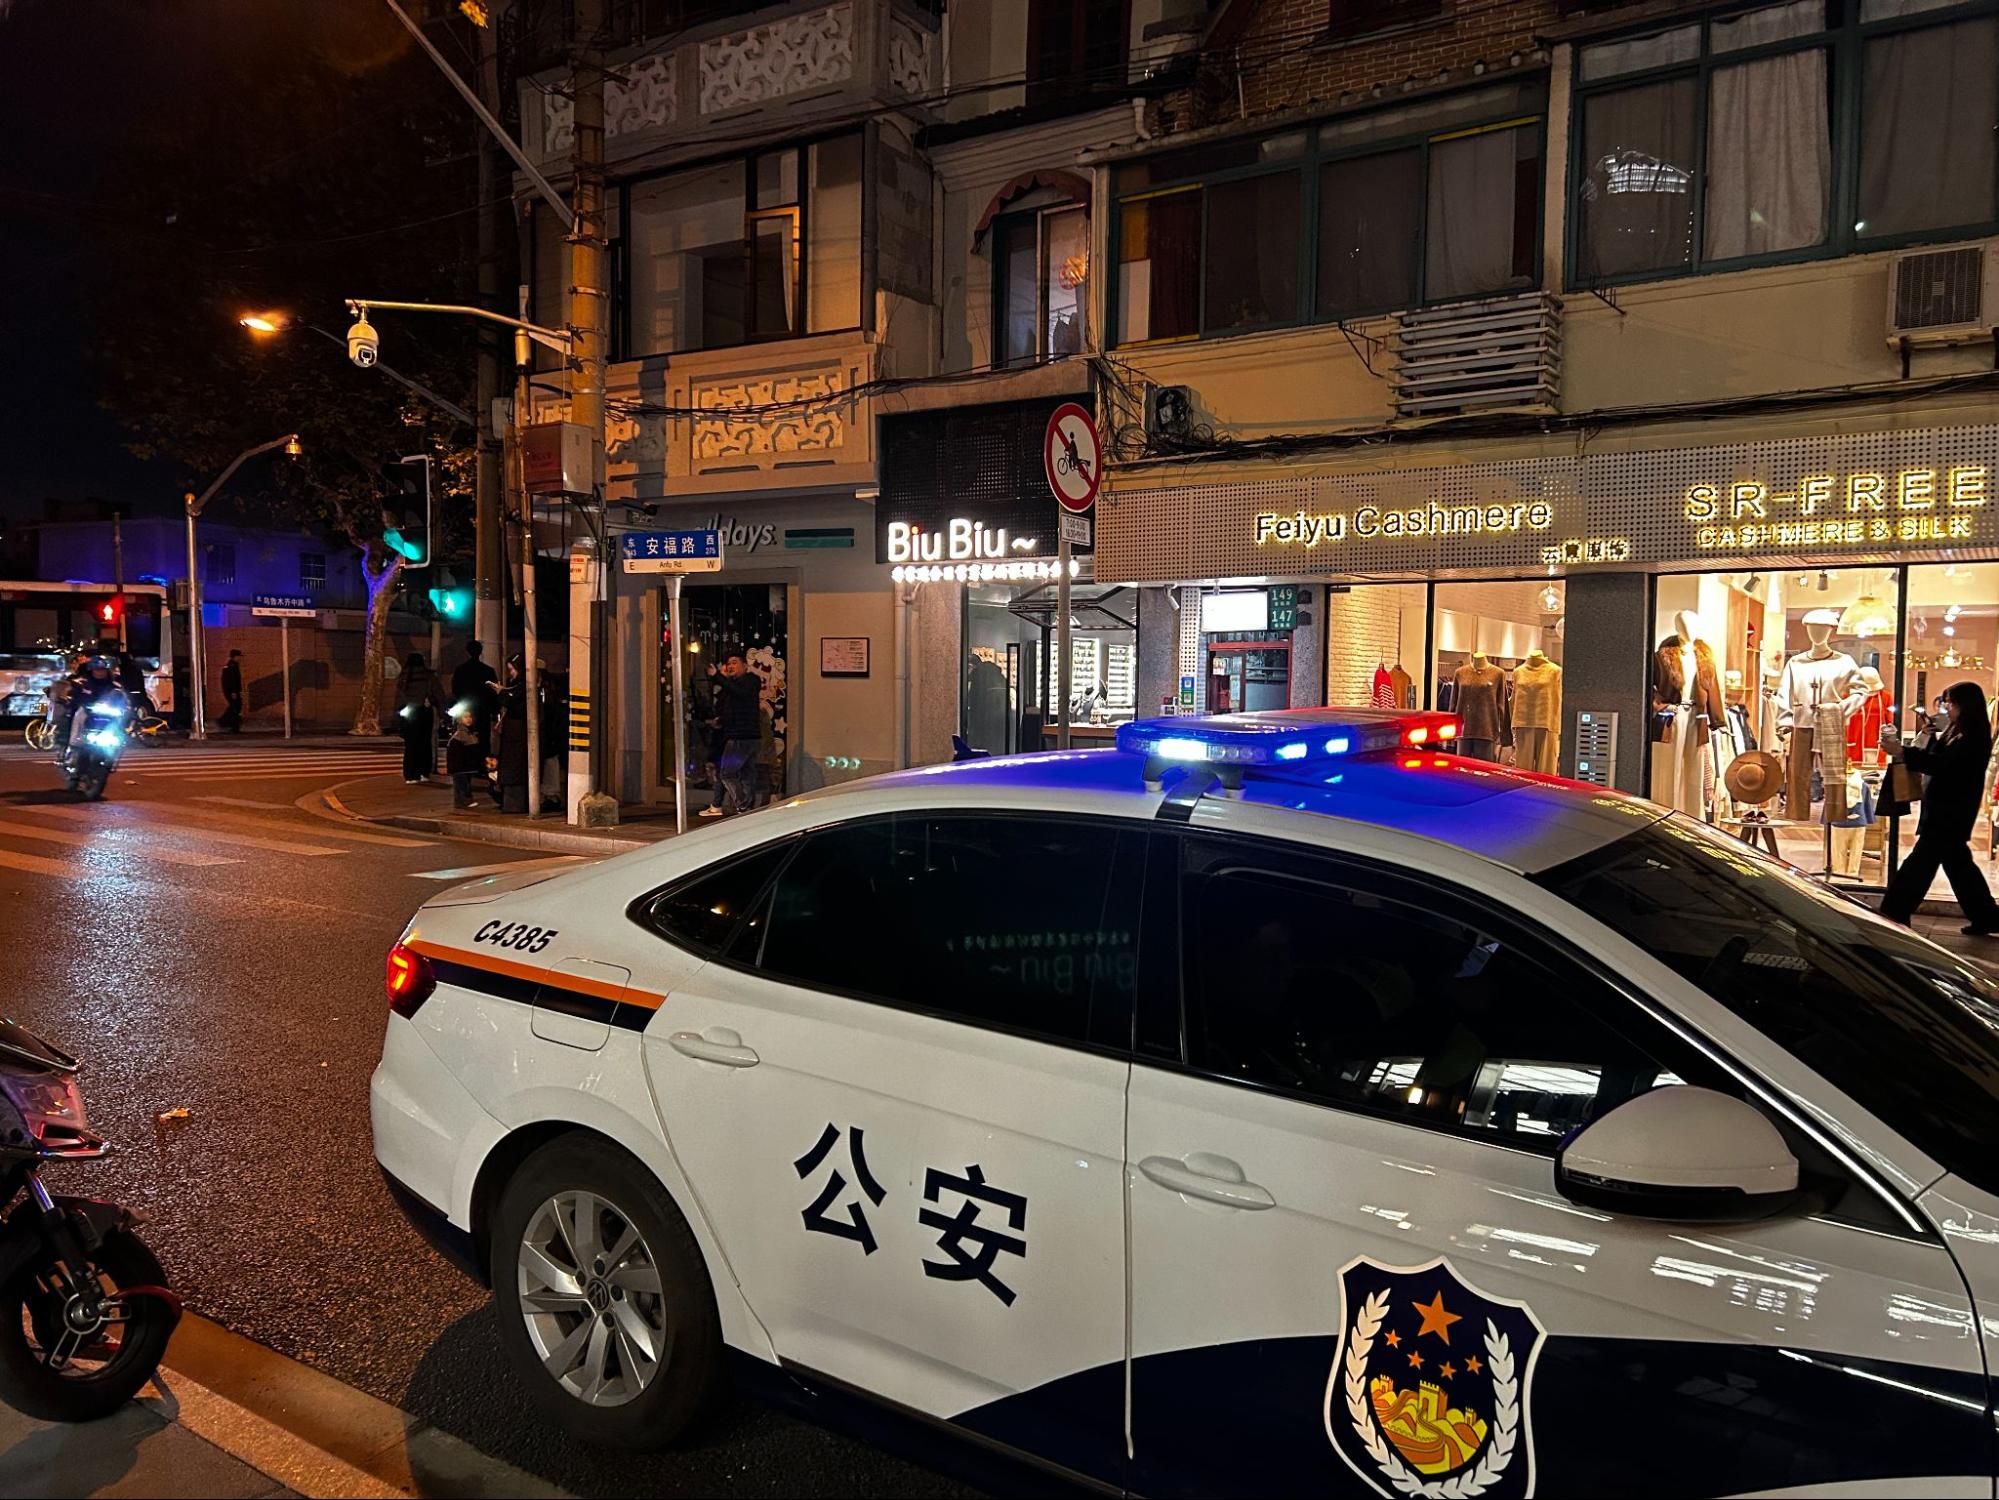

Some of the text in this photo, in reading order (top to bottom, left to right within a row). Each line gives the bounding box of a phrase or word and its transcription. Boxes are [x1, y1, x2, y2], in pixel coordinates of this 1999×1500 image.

[1686, 466, 1985, 519] SR-FREE
[1255, 501, 1550, 545] Feiyu Cashmere
[1698, 515, 1972, 548] CASHMERE & SILK
[646, 537, 694, 555] 安福路
[705, 535, 714, 545] 西
[888, 521, 942, 562] Biu
[949, 518, 1006, 560] Biu
[629, 561, 635, 570] E
[706, 560, 715, 569] W
[1271, 588, 1293, 601] 149
[1271, 610, 1293, 623] 147
[473, 919, 560, 953] C4385
[793, 1121, 1028, 1308] 公安
